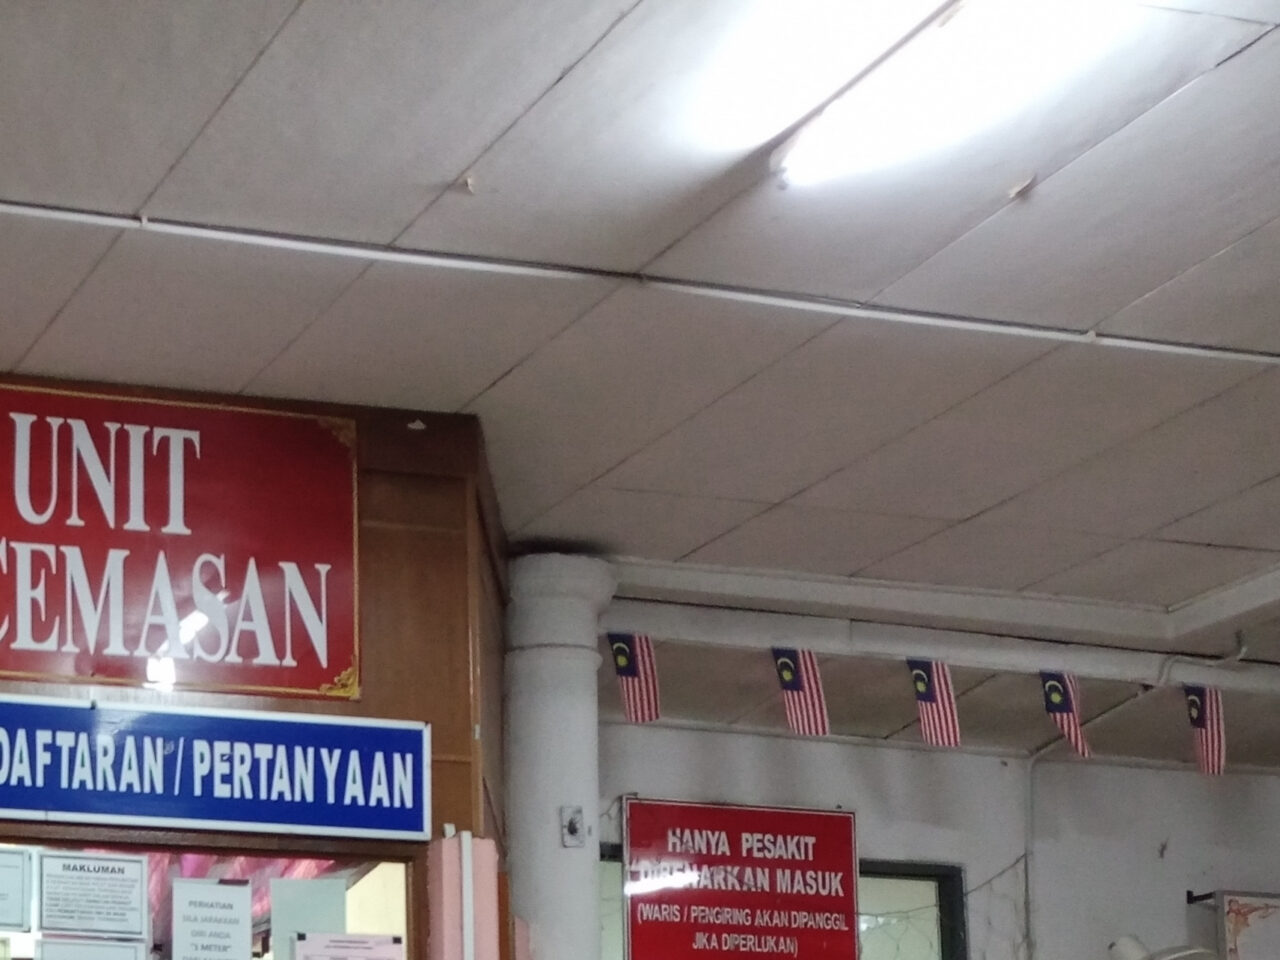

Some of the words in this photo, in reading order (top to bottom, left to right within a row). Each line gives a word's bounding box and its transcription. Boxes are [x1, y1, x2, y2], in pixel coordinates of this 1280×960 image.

[9, 412, 200, 535] UNIT
[192, 738, 415, 810] PERTANYAAN
[667, 828, 730, 857] HANYA
[741, 832, 817, 861] PESAKIT
[62, 863, 125, 875] MAKLUMAN
[776, 869, 844, 897] MASUK
[188, 900, 233, 910] PERHATIAN
[637, 902, 681, 924] (WARIS
[690, 906, 752, 926] PENGIRING
[754, 911, 789, 928] AKAN
[791, 912, 849, 931] DIPANGGIL
[692, 932, 719, 950] JIKA
[721, 933, 798, 957] DIPERLUKAN)
